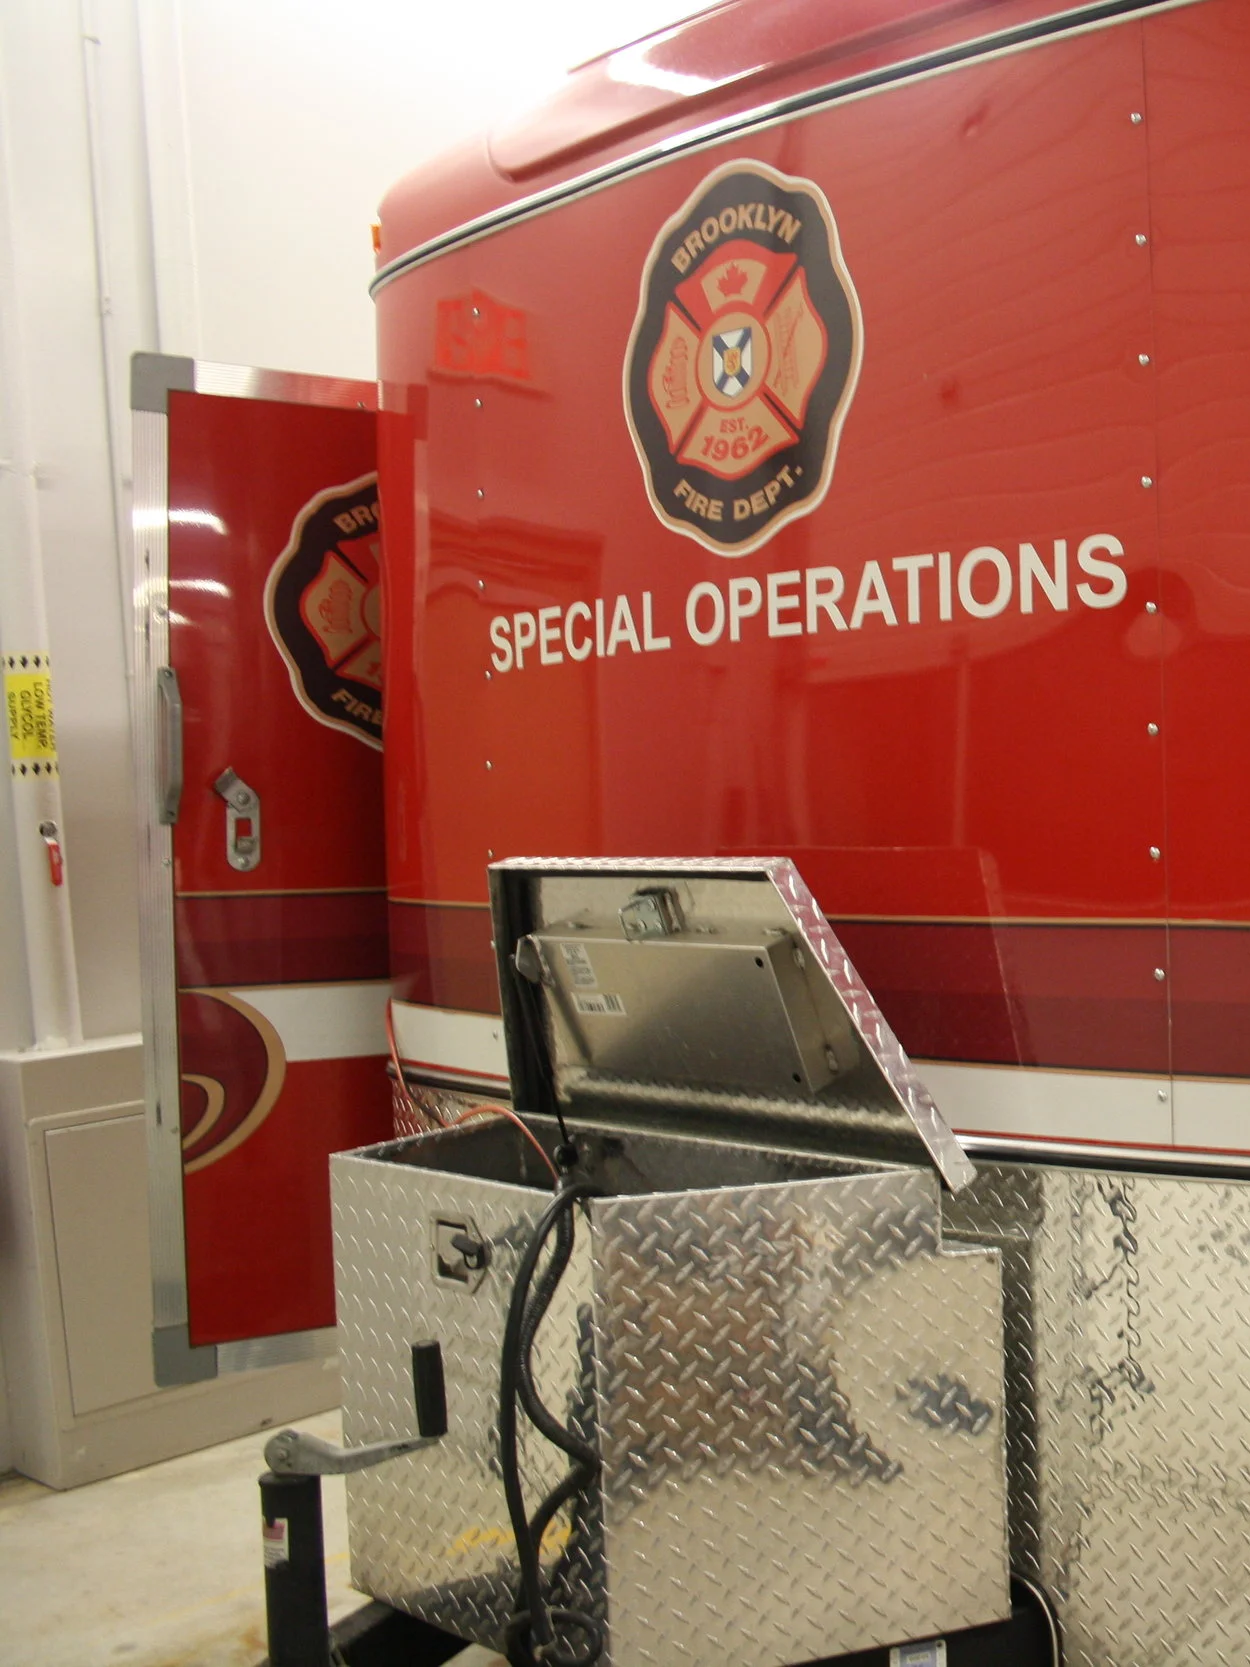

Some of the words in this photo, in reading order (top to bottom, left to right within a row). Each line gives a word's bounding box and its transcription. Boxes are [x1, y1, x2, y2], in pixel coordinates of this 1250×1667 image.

[671, 202, 802, 275] BROOKLYN
[701, 425, 769, 462] 1962
[719, 416, 749, 434] EST.
[673, 478, 724, 521] FIRE
[733, 464, 804, 521] DEPT.
[489, 591, 671, 673] SPECIAL
[685, 533, 1128, 647] OPERATIONS
[20, 690, 34, 740] GLYCOL
